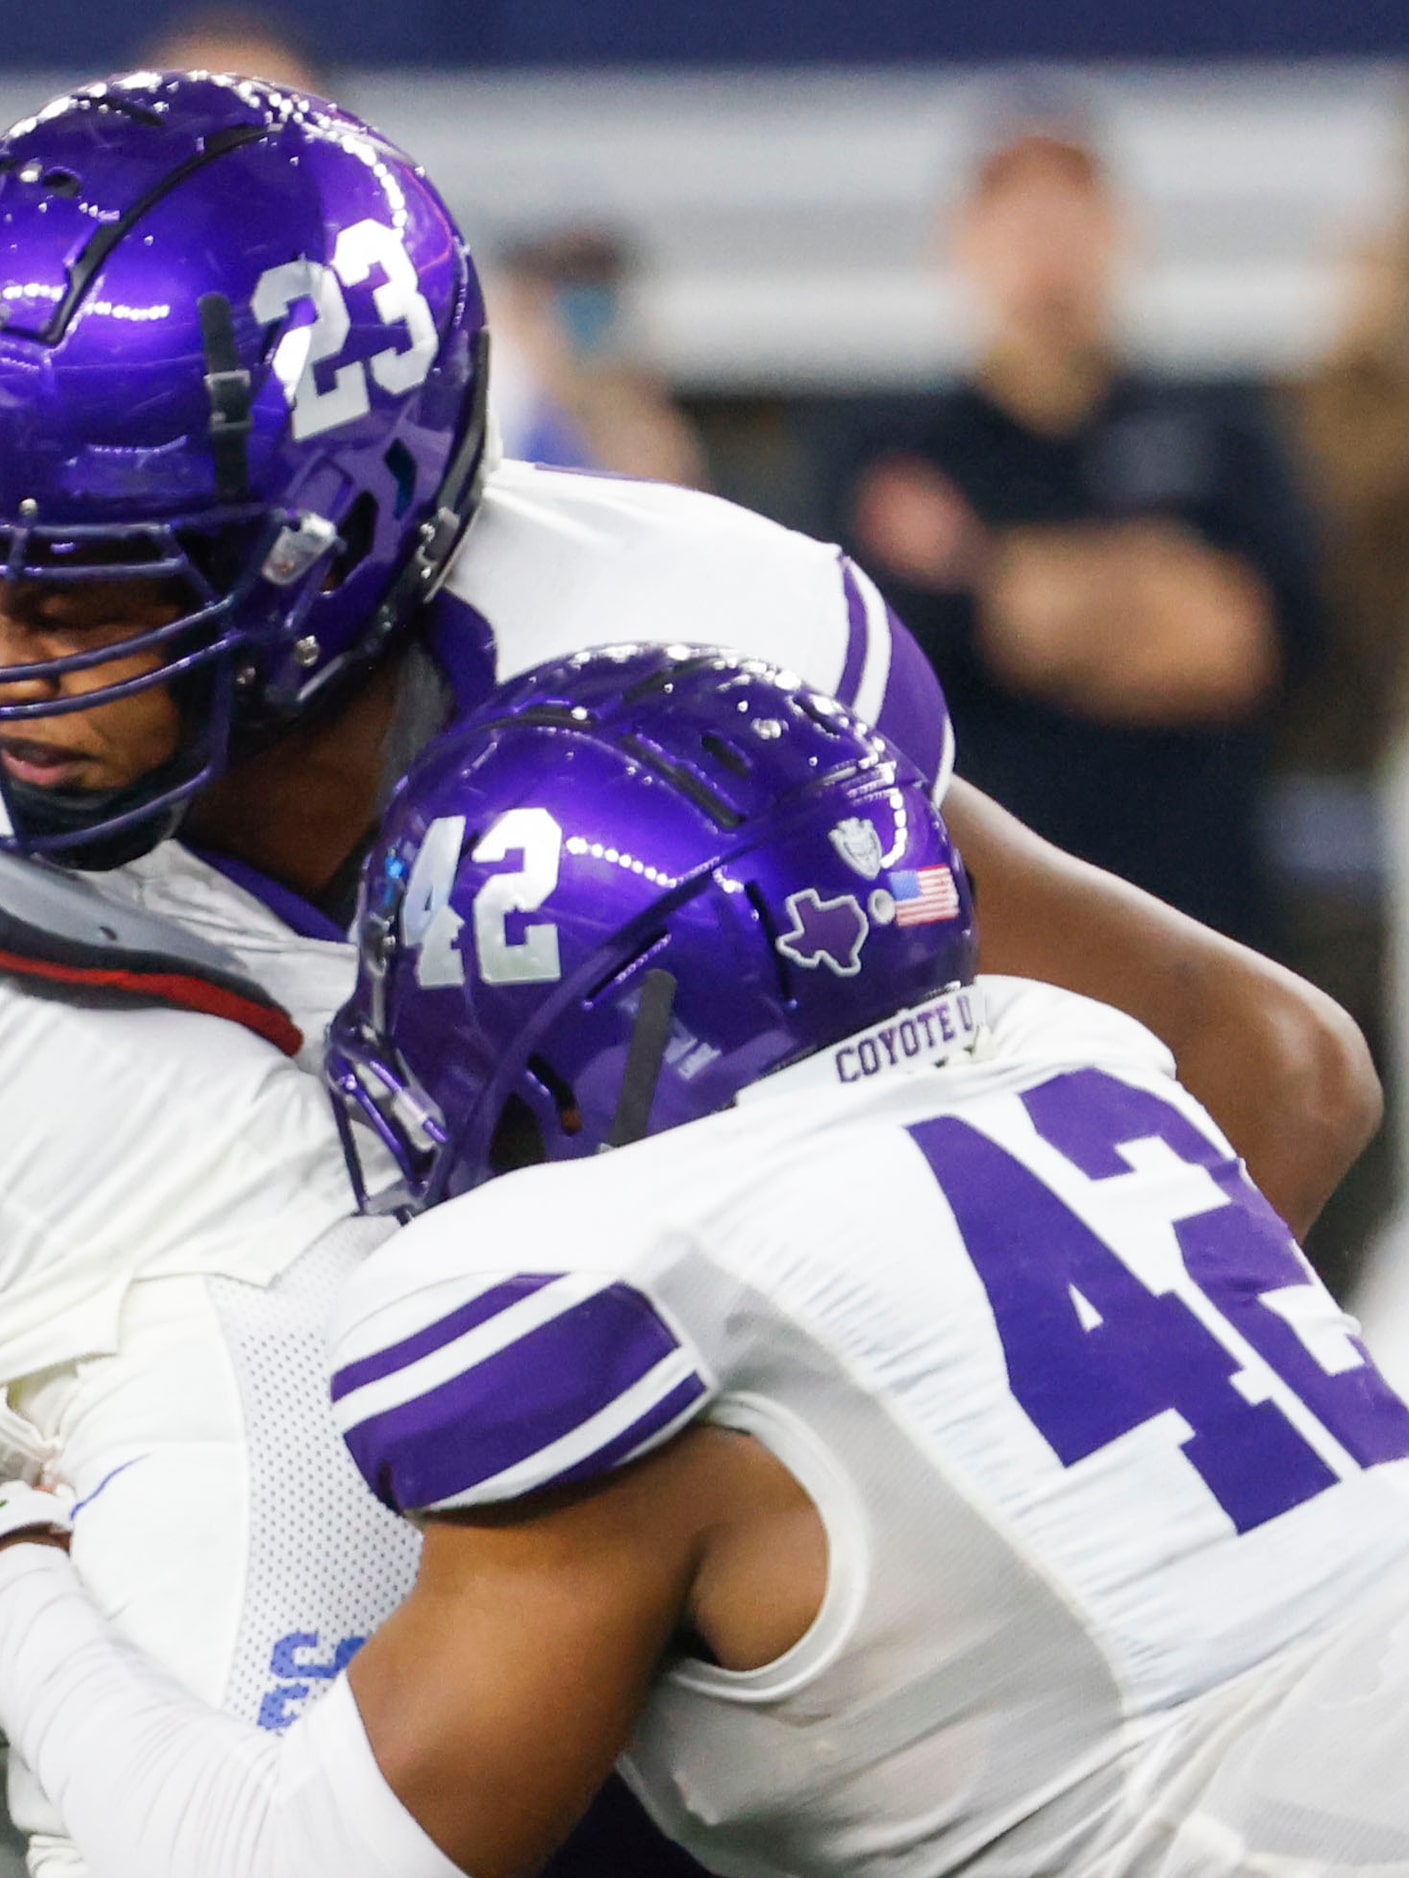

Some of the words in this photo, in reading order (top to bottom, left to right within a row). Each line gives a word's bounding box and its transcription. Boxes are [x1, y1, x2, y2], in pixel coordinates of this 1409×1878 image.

[249, 217, 439, 443] 23
[401, 807, 563, 989] 42
[835, 1003, 956, 1084] COYOTE
[903, 1066, 1409, 1537] 42
